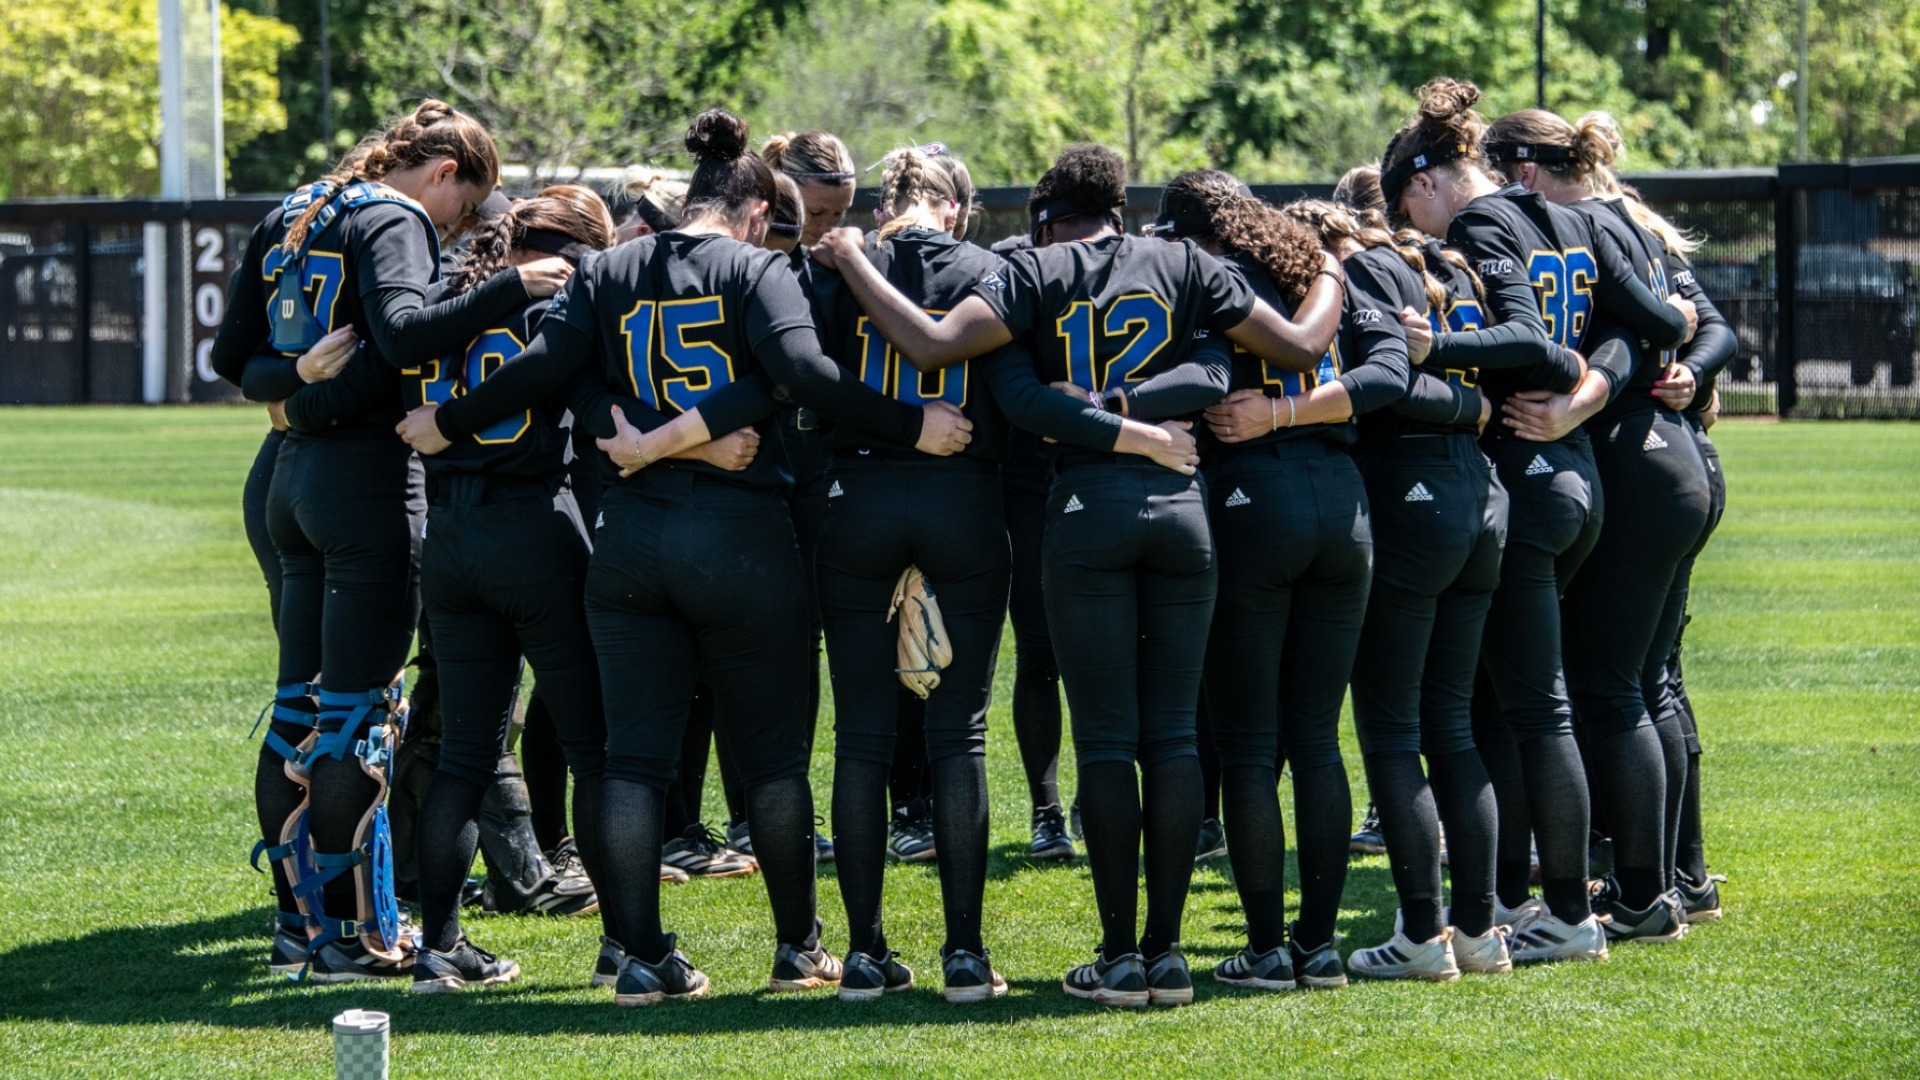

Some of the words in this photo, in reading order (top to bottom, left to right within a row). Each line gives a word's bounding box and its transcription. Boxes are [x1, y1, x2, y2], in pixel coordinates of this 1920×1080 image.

[1056, 293, 1172, 392] 12
[1527, 247, 1598, 352] 36
[620, 295, 735, 413] 15
